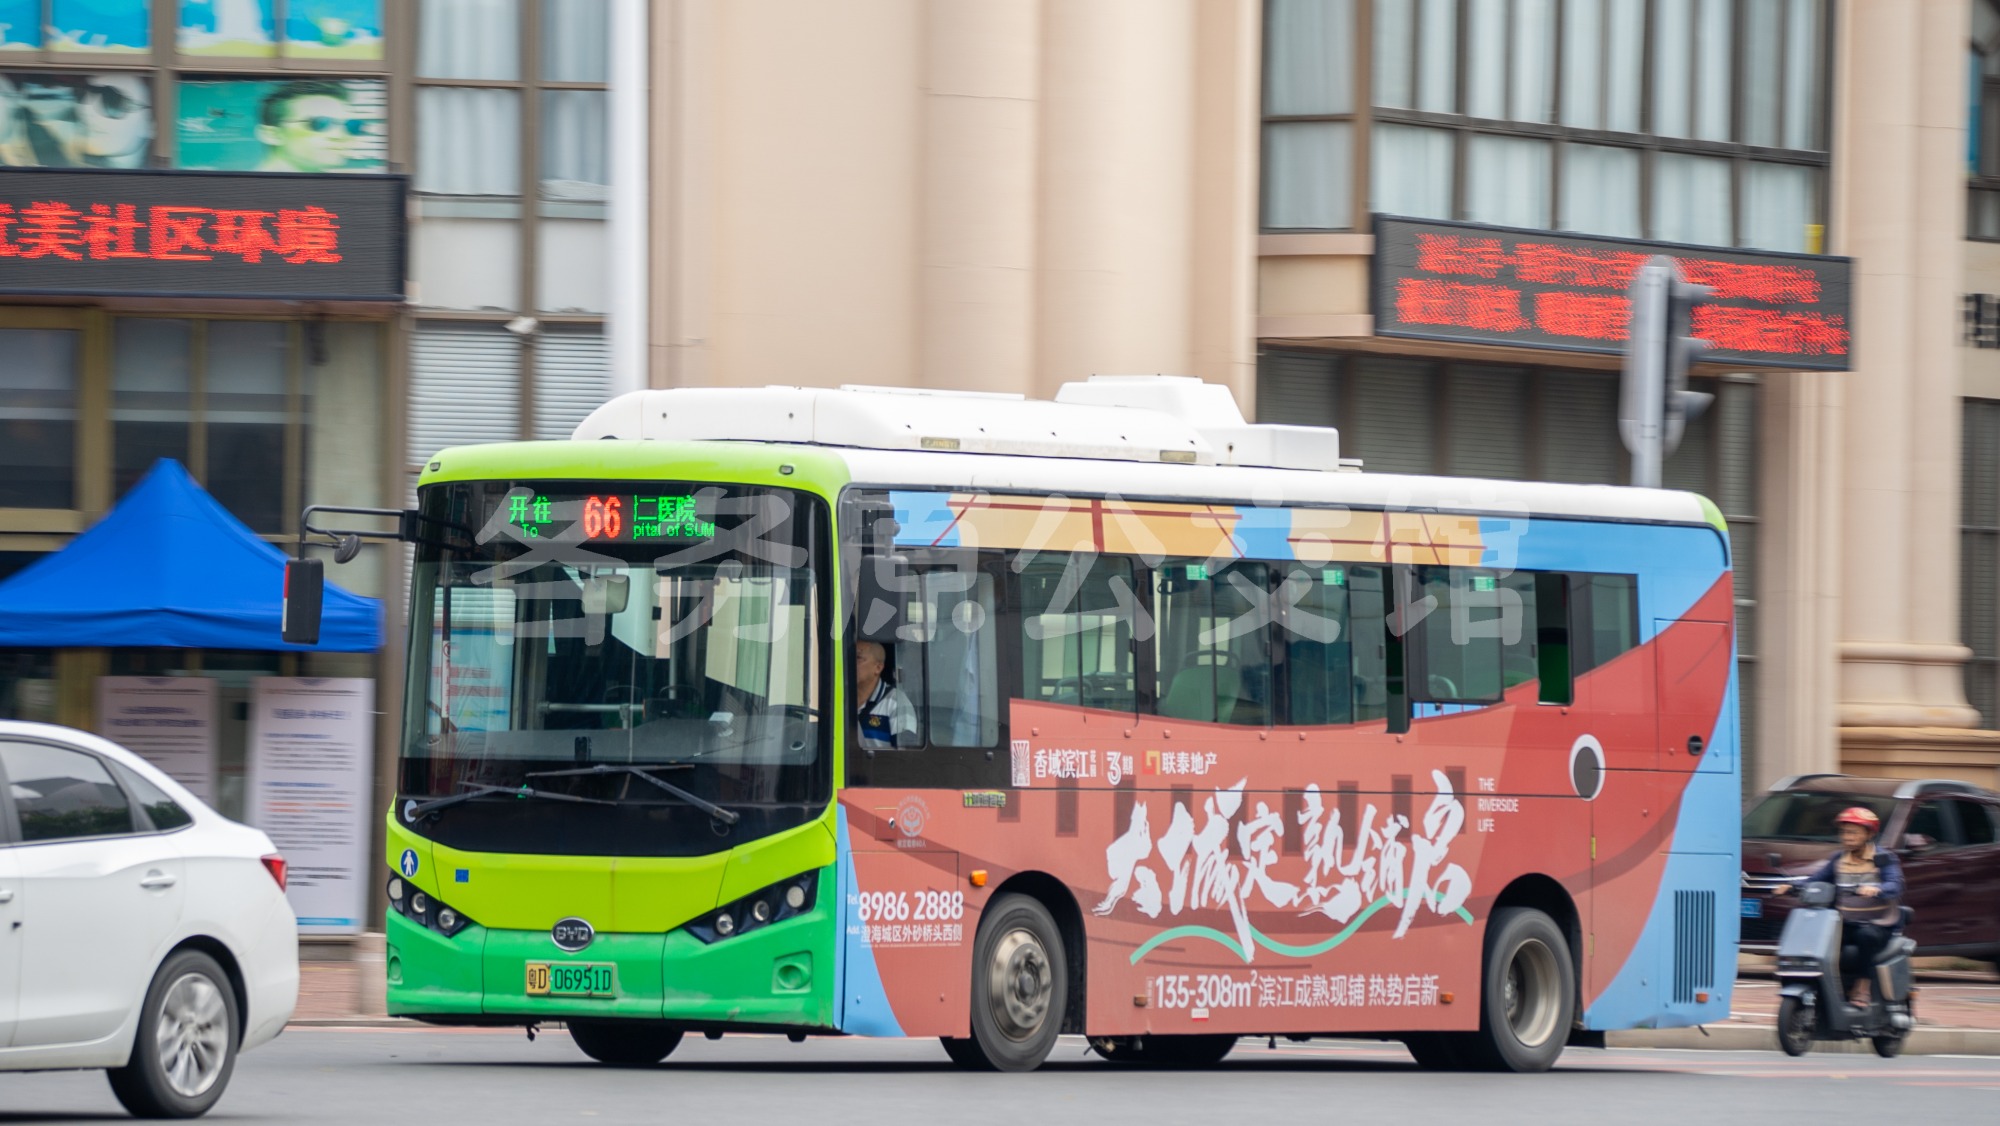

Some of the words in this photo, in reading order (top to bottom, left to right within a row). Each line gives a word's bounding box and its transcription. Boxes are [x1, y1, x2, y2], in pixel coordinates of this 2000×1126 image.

[509, 496, 552, 524] 开往
[584, 495, 621, 538] 66
[522, 524, 539, 538] To
[633, 523, 661, 540] pital
[666, 522, 680, 537] of
[1161, 751, 1218, 775] 联泰地产
[1478, 777, 1495, 792] THE
[1477, 798, 1519, 812] RIVERSIDE
[1477, 818, 1495, 832] LIFE
[858, 891, 909, 921] 8986
[913, 890, 964, 920] 2888
[556, 926, 589, 941] BYD
[1368, 974, 1439, 1006] 热势启新
